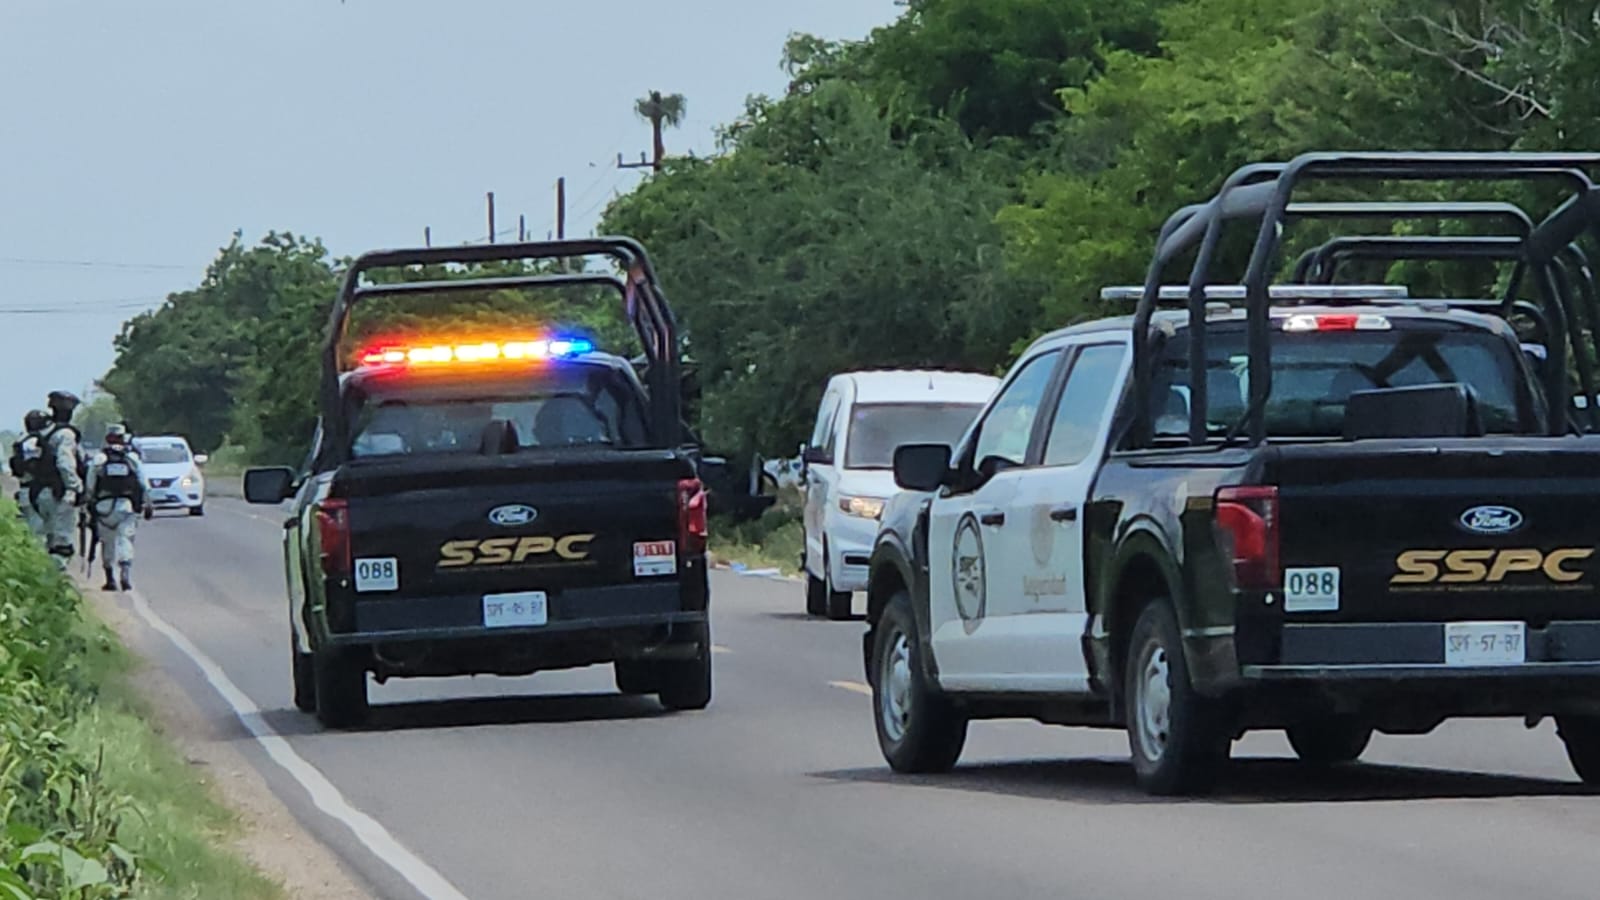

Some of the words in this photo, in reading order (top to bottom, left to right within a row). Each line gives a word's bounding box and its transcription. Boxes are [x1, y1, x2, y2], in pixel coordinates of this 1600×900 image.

[1470, 508, 1512, 530] Ford
[439, 533, 597, 566] SSPC
[358, 561, 395, 580] 088
[1391, 549, 1595, 583] SSPC
[1288, 571, 1334, 595] 088
